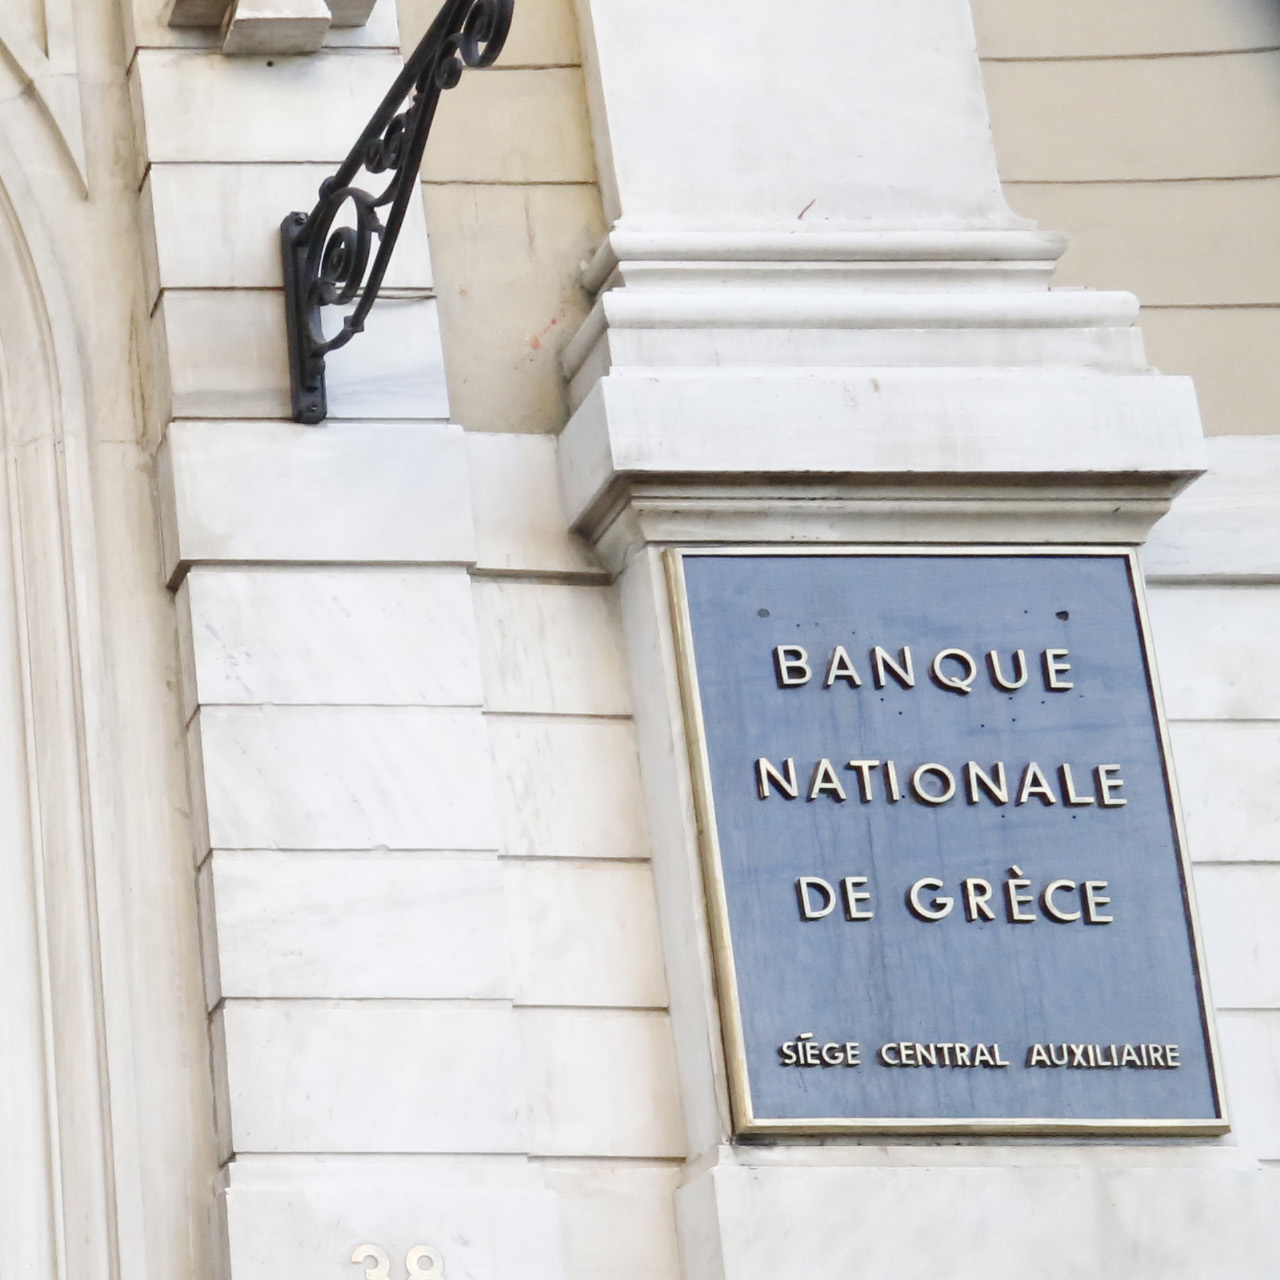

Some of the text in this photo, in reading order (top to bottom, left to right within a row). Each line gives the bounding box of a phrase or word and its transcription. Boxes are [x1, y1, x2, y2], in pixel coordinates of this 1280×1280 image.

[775, 645, 1074, 692] BANQUE
[757, 757, 1127, 805] NATIONALE
[797, 864, 1114, 923] DE GRÈCE
[881, 1041, 1010, 1067] CENTRAL
[1030, 1042, 1181, 1068] AUXILIAIRE
